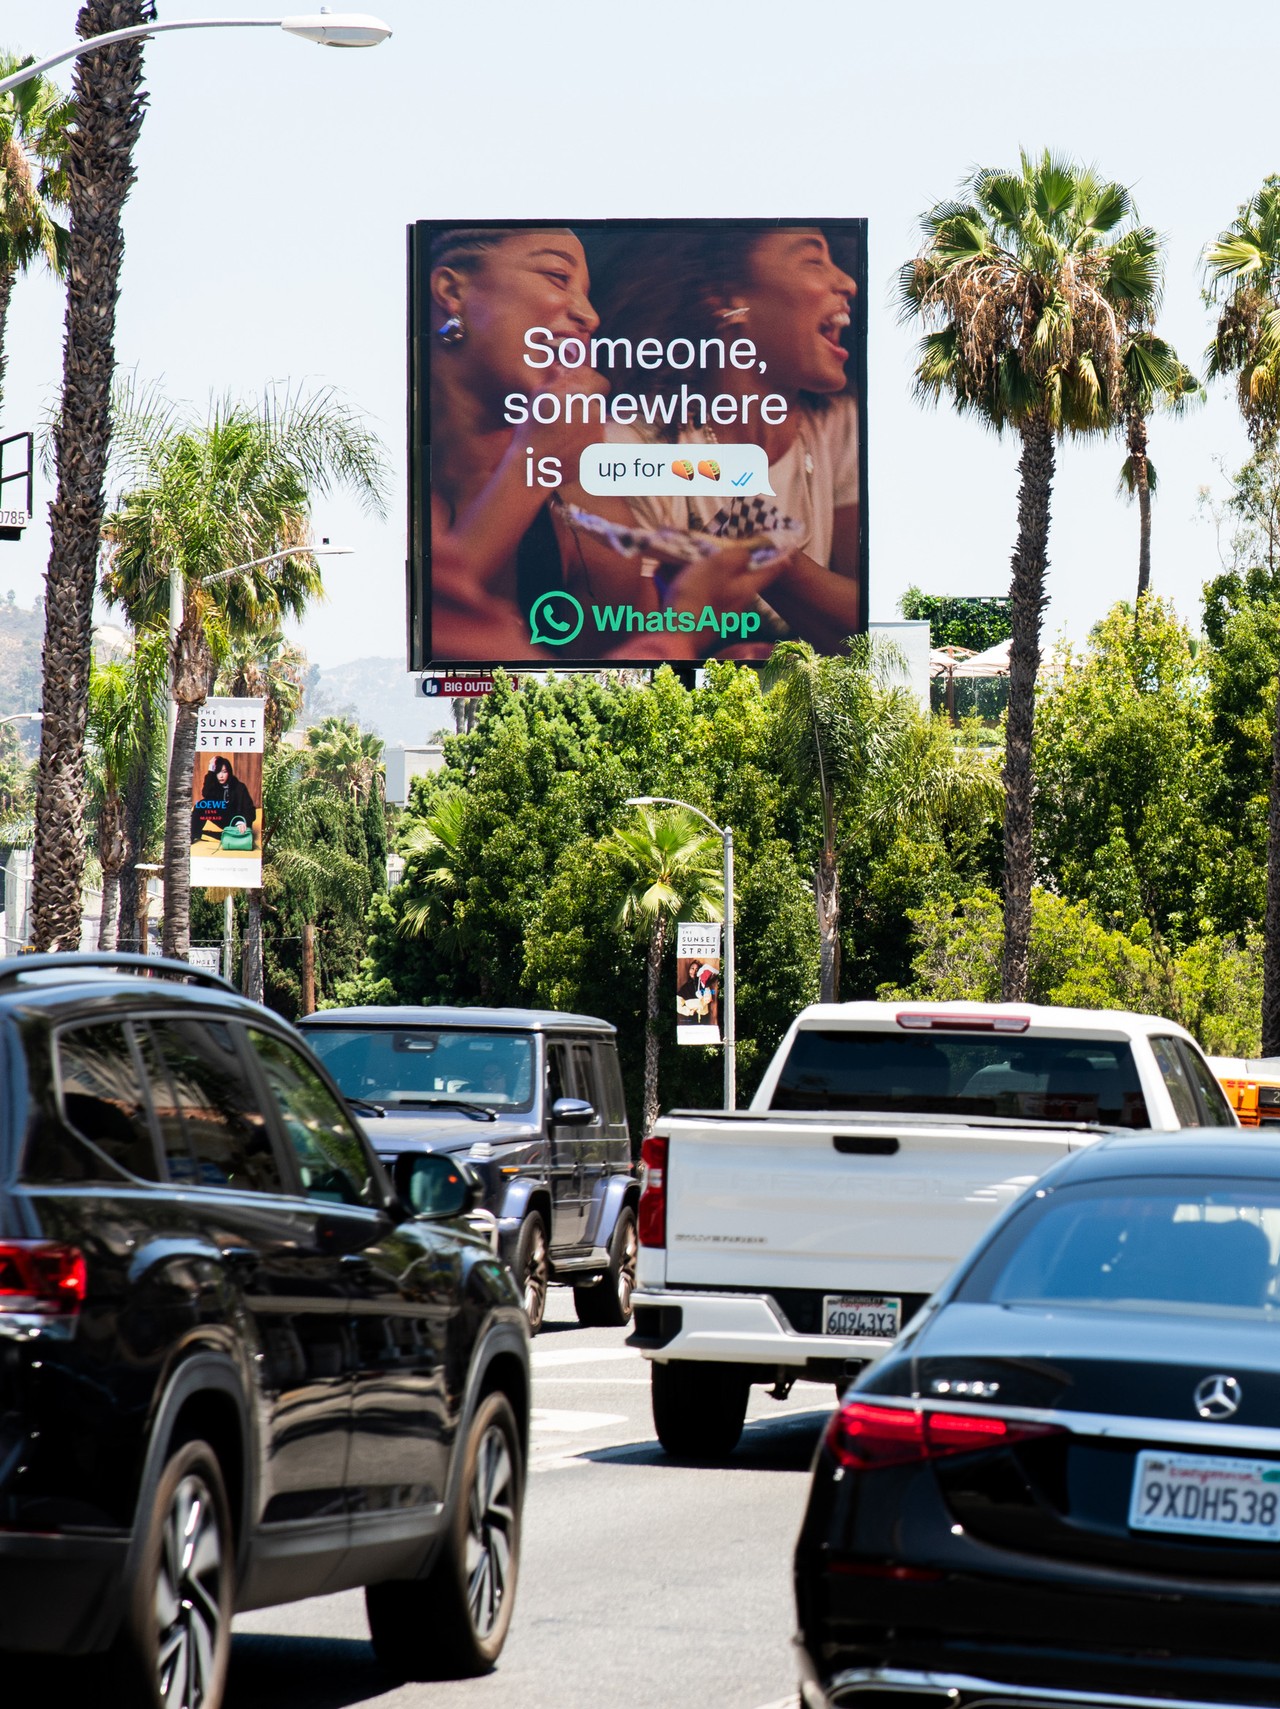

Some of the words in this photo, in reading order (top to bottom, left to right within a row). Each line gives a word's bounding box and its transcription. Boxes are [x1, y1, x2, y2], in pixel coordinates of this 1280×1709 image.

[523, 326, 767, 374] Someone,
[503, 384, 788, 425] somewhere
[526, 447, 563, 488] is
[598, 461, 627, 481] up
[633, 458, 665, 477] for
[591, 605, 761, 638] WhatsApp
[444, 682, 462, 692] BIG
[464, 682, 515, 692] OUTDR
[200, 719, 256, 728] SUNSET
[200, 736, 256, 746] STRIP
[195, 800, 227, 809] LOEWE
[1273, 1091, 1280, 1104] 2
[828, 1311, 897, 1332] 60943Y3
[1144, 1481, 1278, 1526] 9XDH538
